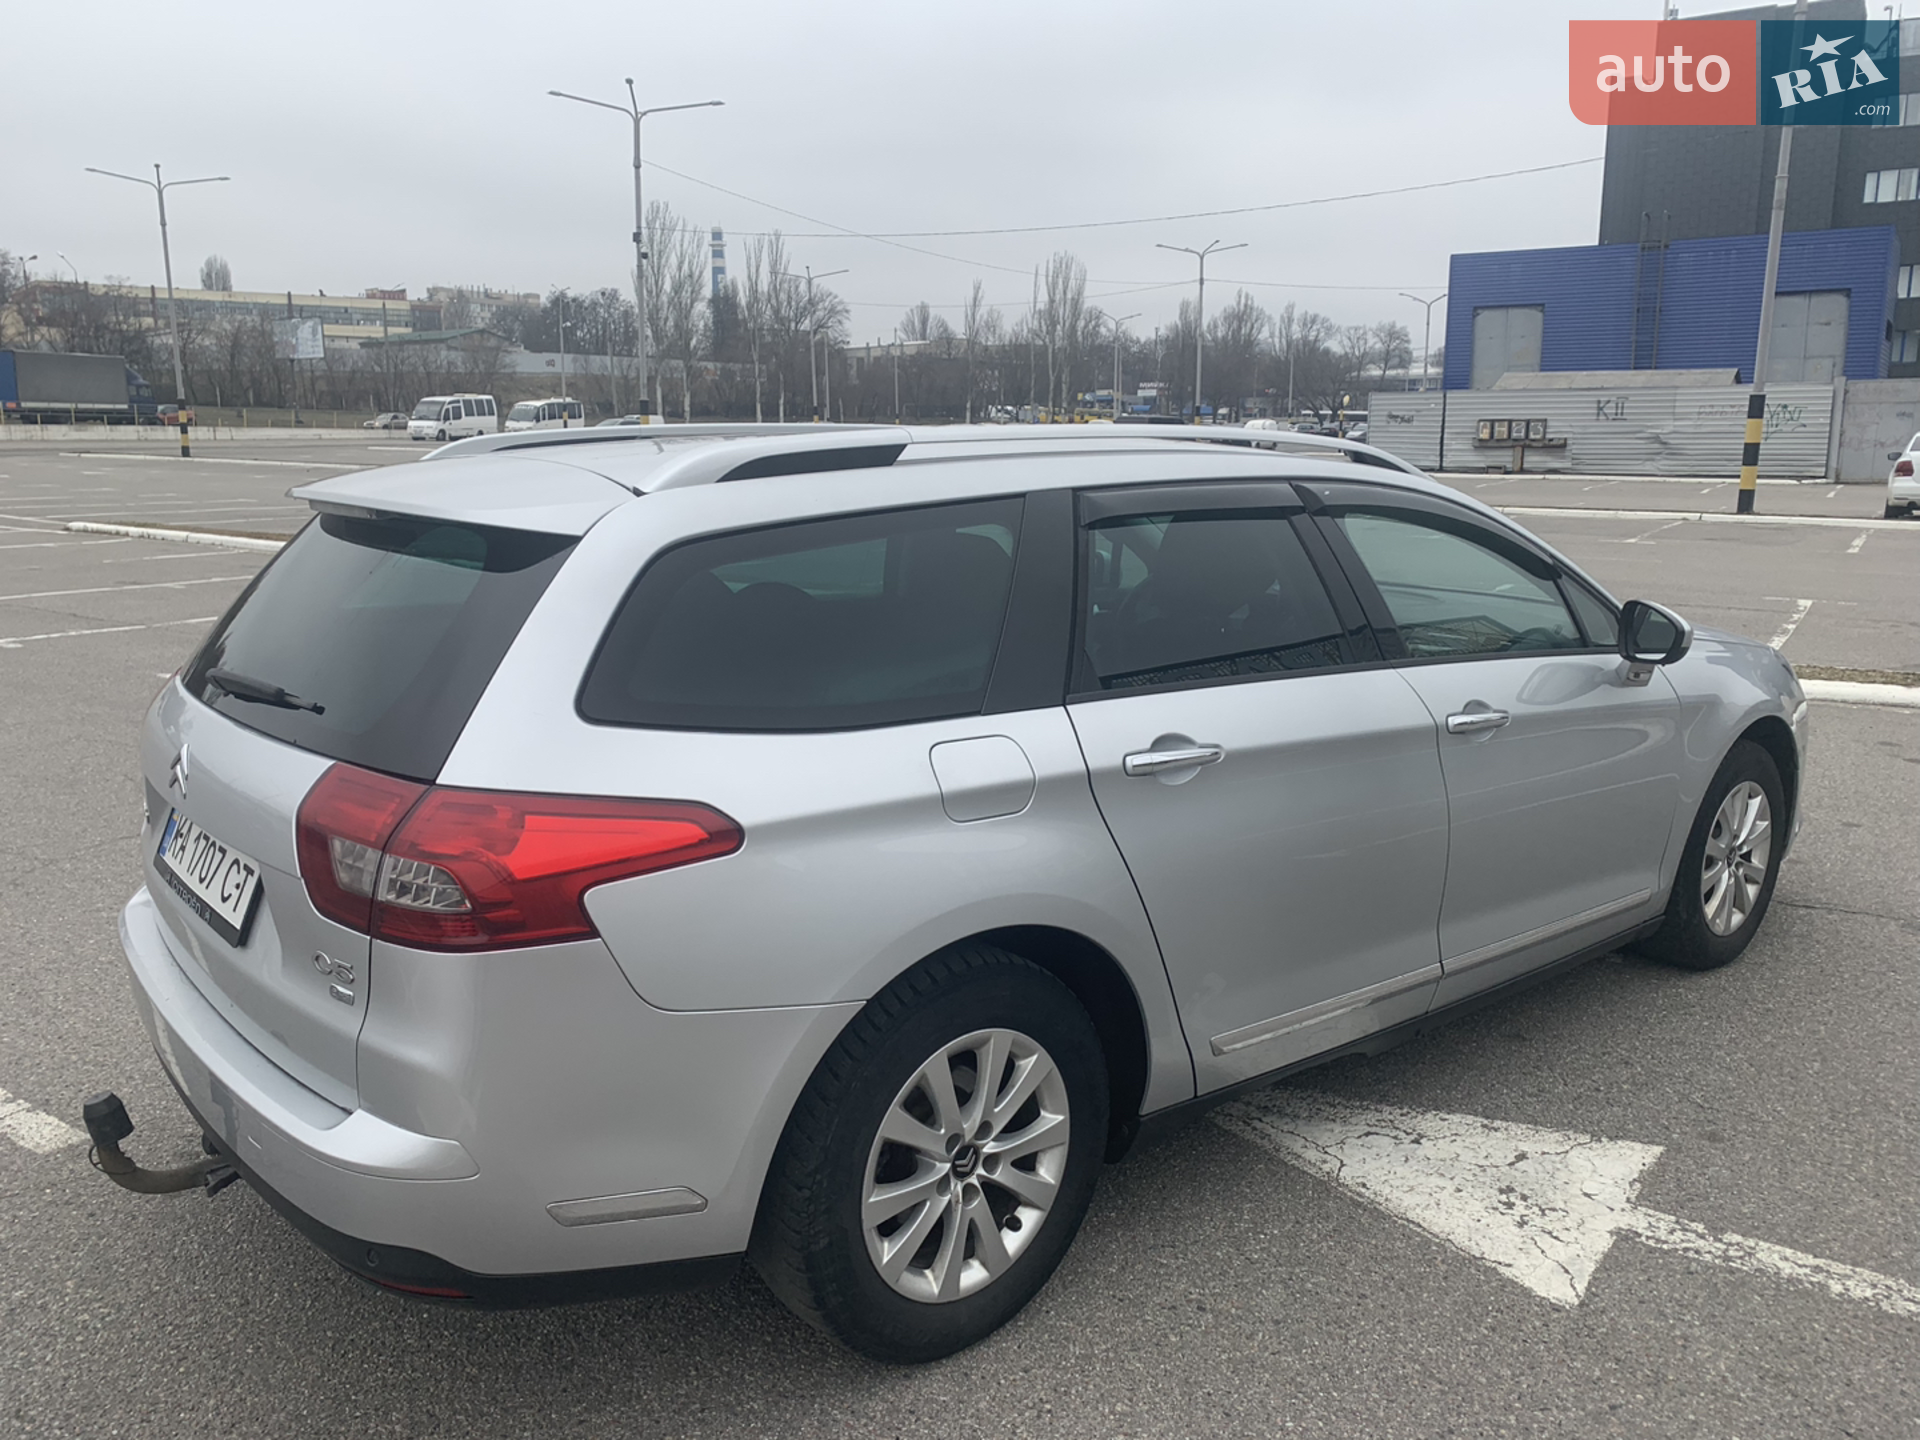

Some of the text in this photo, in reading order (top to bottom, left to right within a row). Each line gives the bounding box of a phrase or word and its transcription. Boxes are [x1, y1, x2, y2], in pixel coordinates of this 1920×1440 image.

[187, 829, 228, 891] 1707
[220, 857, 256, 913] CT
[312, 949, 355, 985] C5
